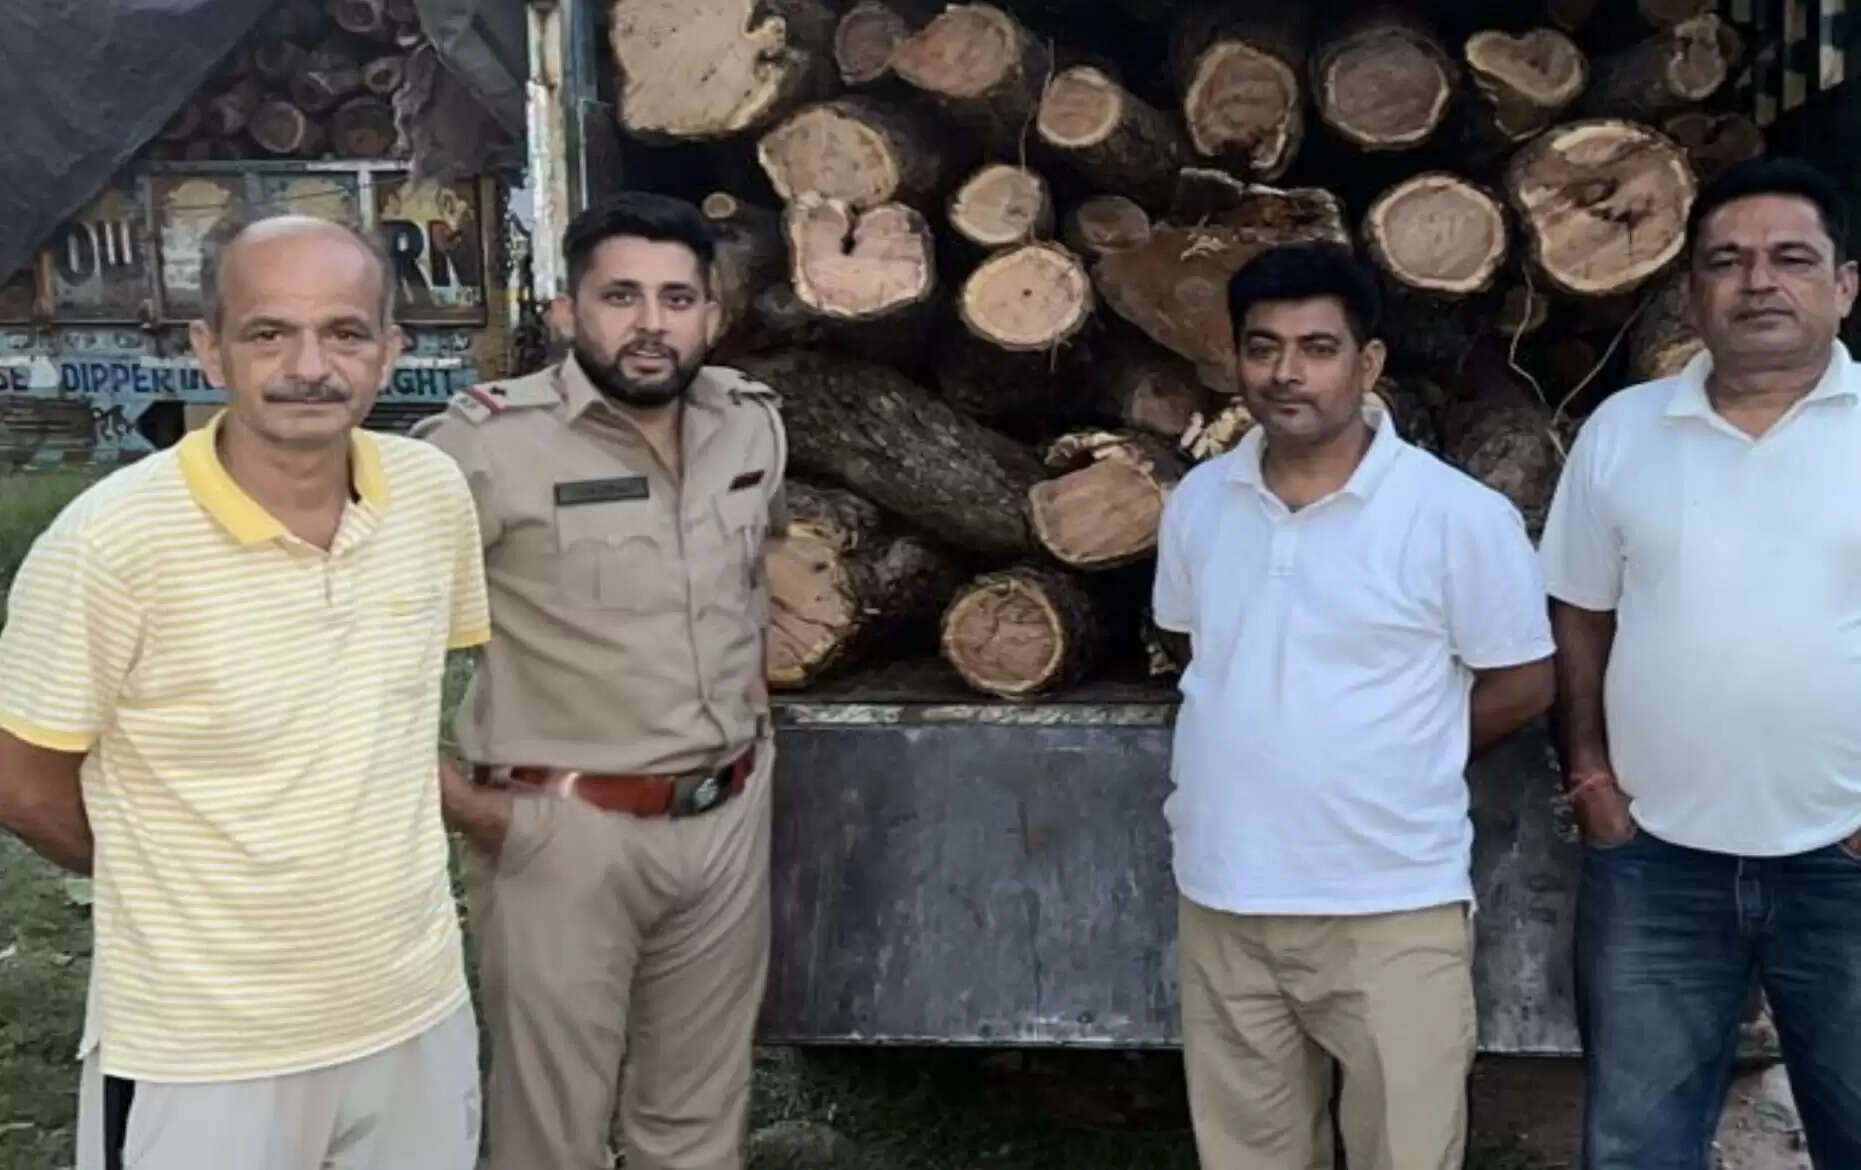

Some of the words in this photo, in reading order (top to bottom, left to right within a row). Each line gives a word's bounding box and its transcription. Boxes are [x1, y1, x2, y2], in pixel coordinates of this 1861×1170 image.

[384, 219, 481, 302] RN
[0, 368, 29, 391] SE
[61, 363, 177, 393] DIPPER
[380, 367, 459, 395] GHT
